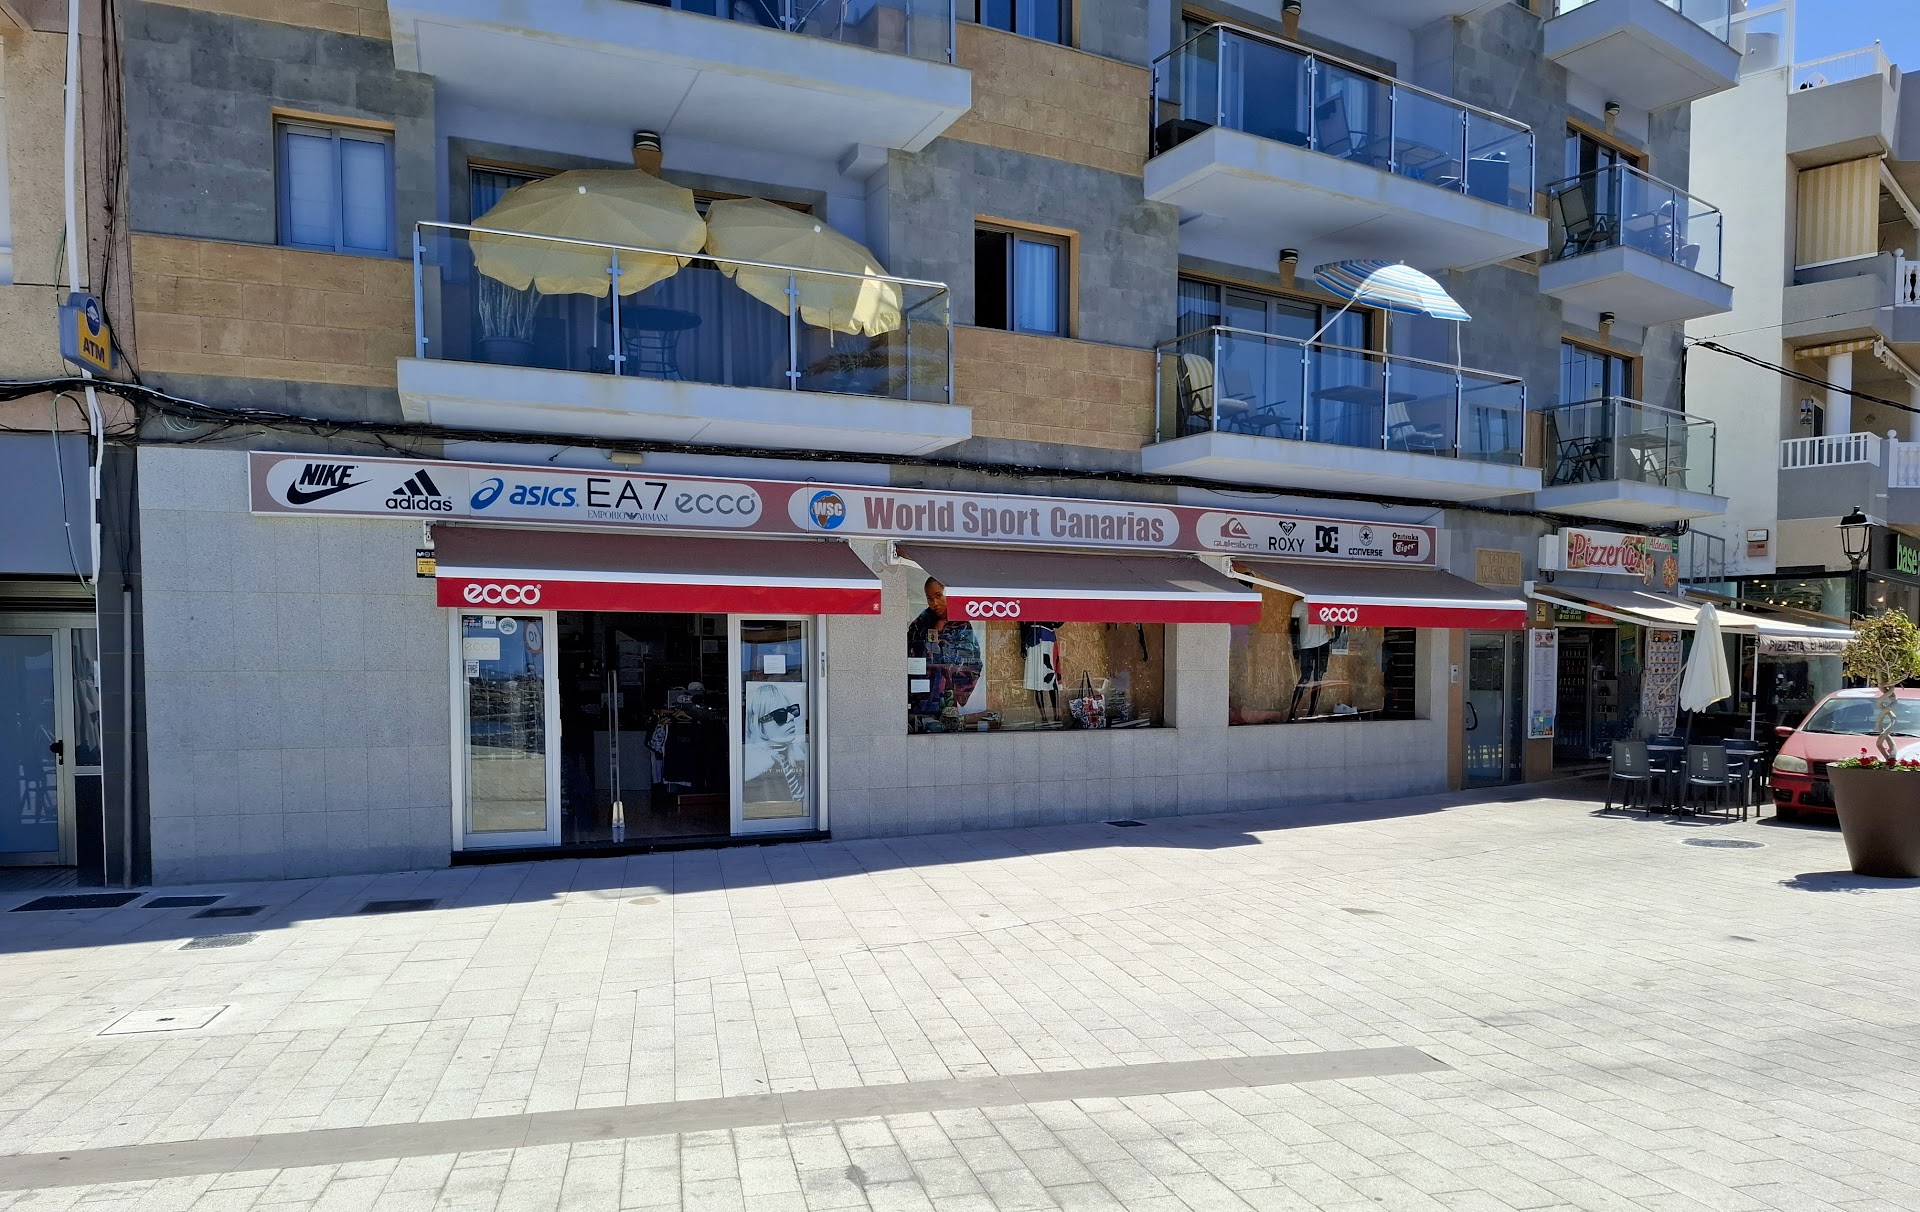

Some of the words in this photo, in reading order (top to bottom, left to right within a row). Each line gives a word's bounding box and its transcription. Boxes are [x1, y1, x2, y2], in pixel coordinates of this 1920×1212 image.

[83, 337, 105, 363] ATM
[299, 463, 355, 487] NIKE
[385, 495, 453, 512] adidas
[587, 477, 668, 511] EA7
[675, 493, 756, 515] ecco
[587, 510, 627, 520] EMPORIO
[637, 512, 669, 522] ARMANI
[814, 502, 843, 516] WSC
[864, 496, 954, 532] World
[962, 501, 1040, 537] Sport
[1050, 507, 1164, 542] Canarias
[1269, 536, 1305, 552] ROXY
[1315, 525, 1338, 553] DC
[1395, 541, 1416, 553] Tiger
[1348, 548, 1383, 557] CONVERSE
[1571, 533, 1638, 567] Pizzería
[1896, 533, 1920, 575] base
[463, 583, 541, 605] ecco
[965, 600, 1020, 618] ecco
[1319, 607, 1358, 623] ecco
[465, 642, 498, 651] ecco
